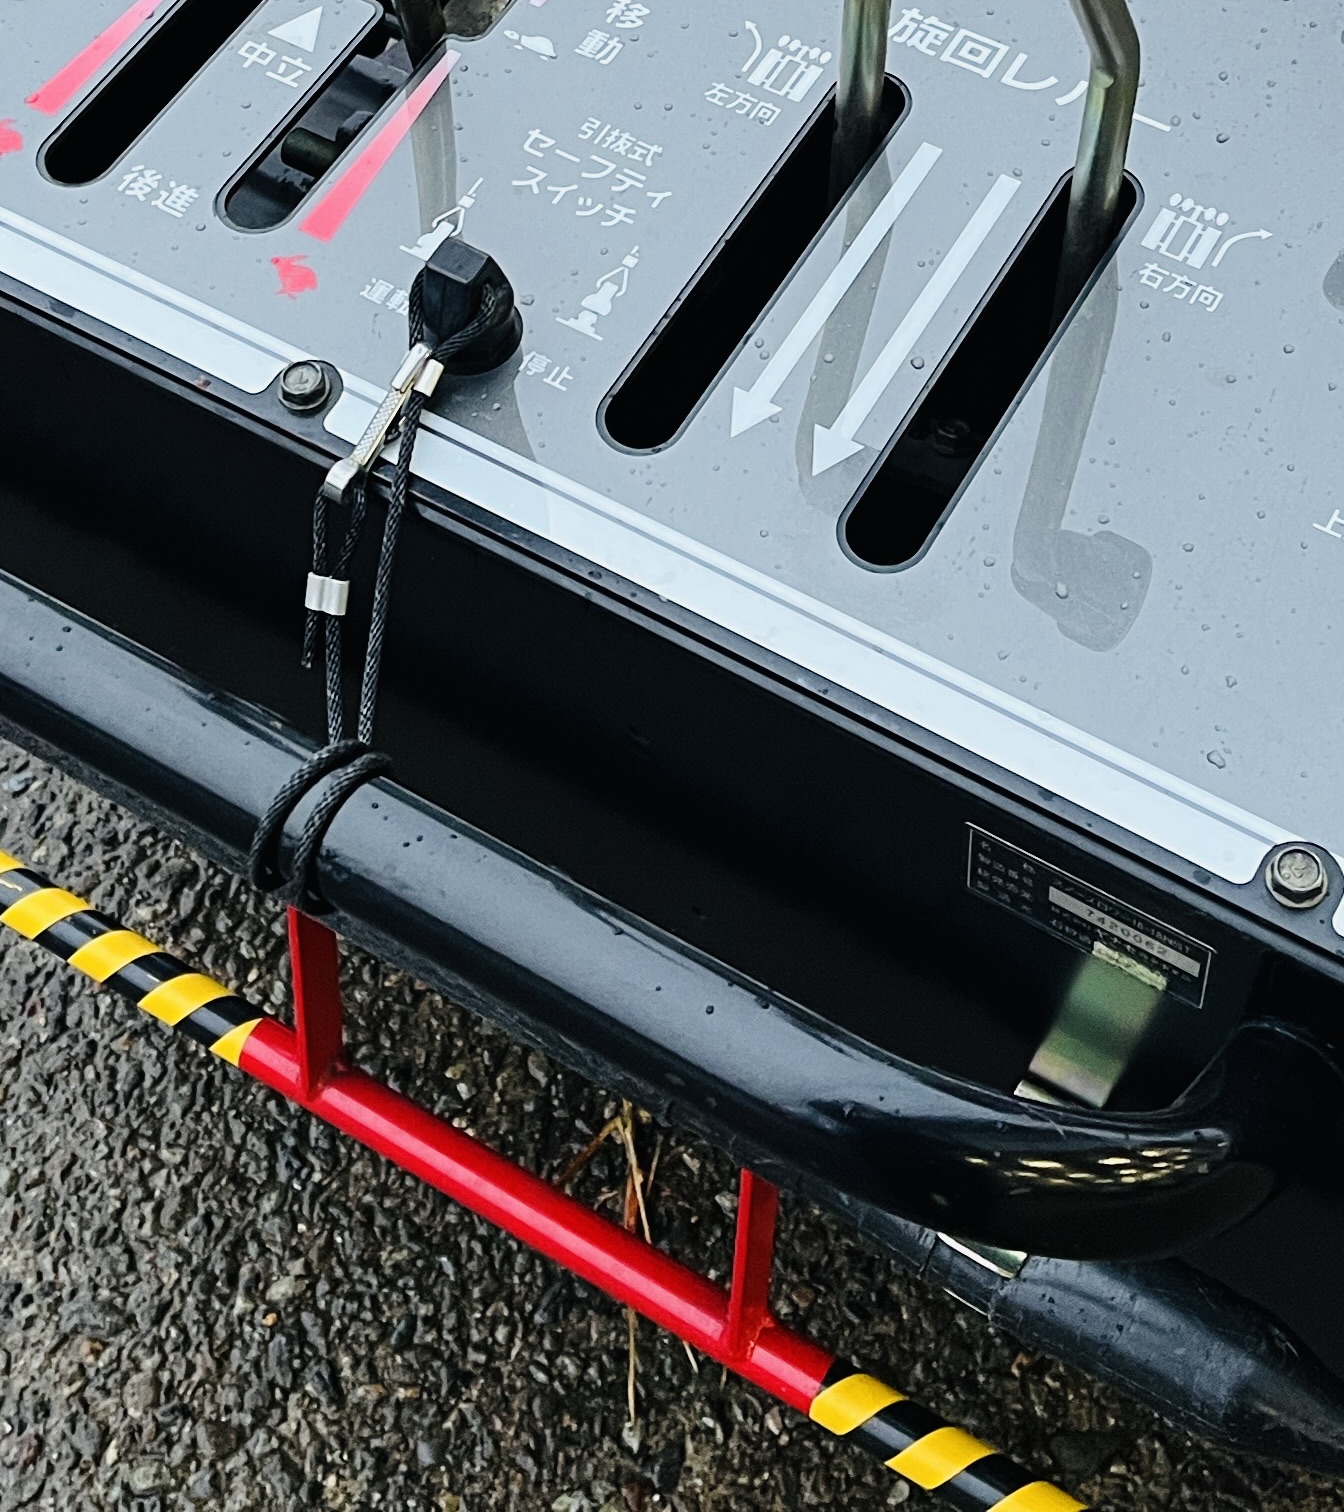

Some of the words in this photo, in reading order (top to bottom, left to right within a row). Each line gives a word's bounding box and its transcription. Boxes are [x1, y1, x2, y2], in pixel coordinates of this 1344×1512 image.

[236, 39, 313, 88] 中立
[703, 82, 782, 126] 左方向
[578, 117, 663, 167] 引抜式
[117, 164, 199, 218] 後進
[522, 128, 673, 208] セーフティ
[512, 165, 636, 227] スイッチ
[1138, 262, 1224, 312] 右方向
[518, 350, 573, 391] 停止
